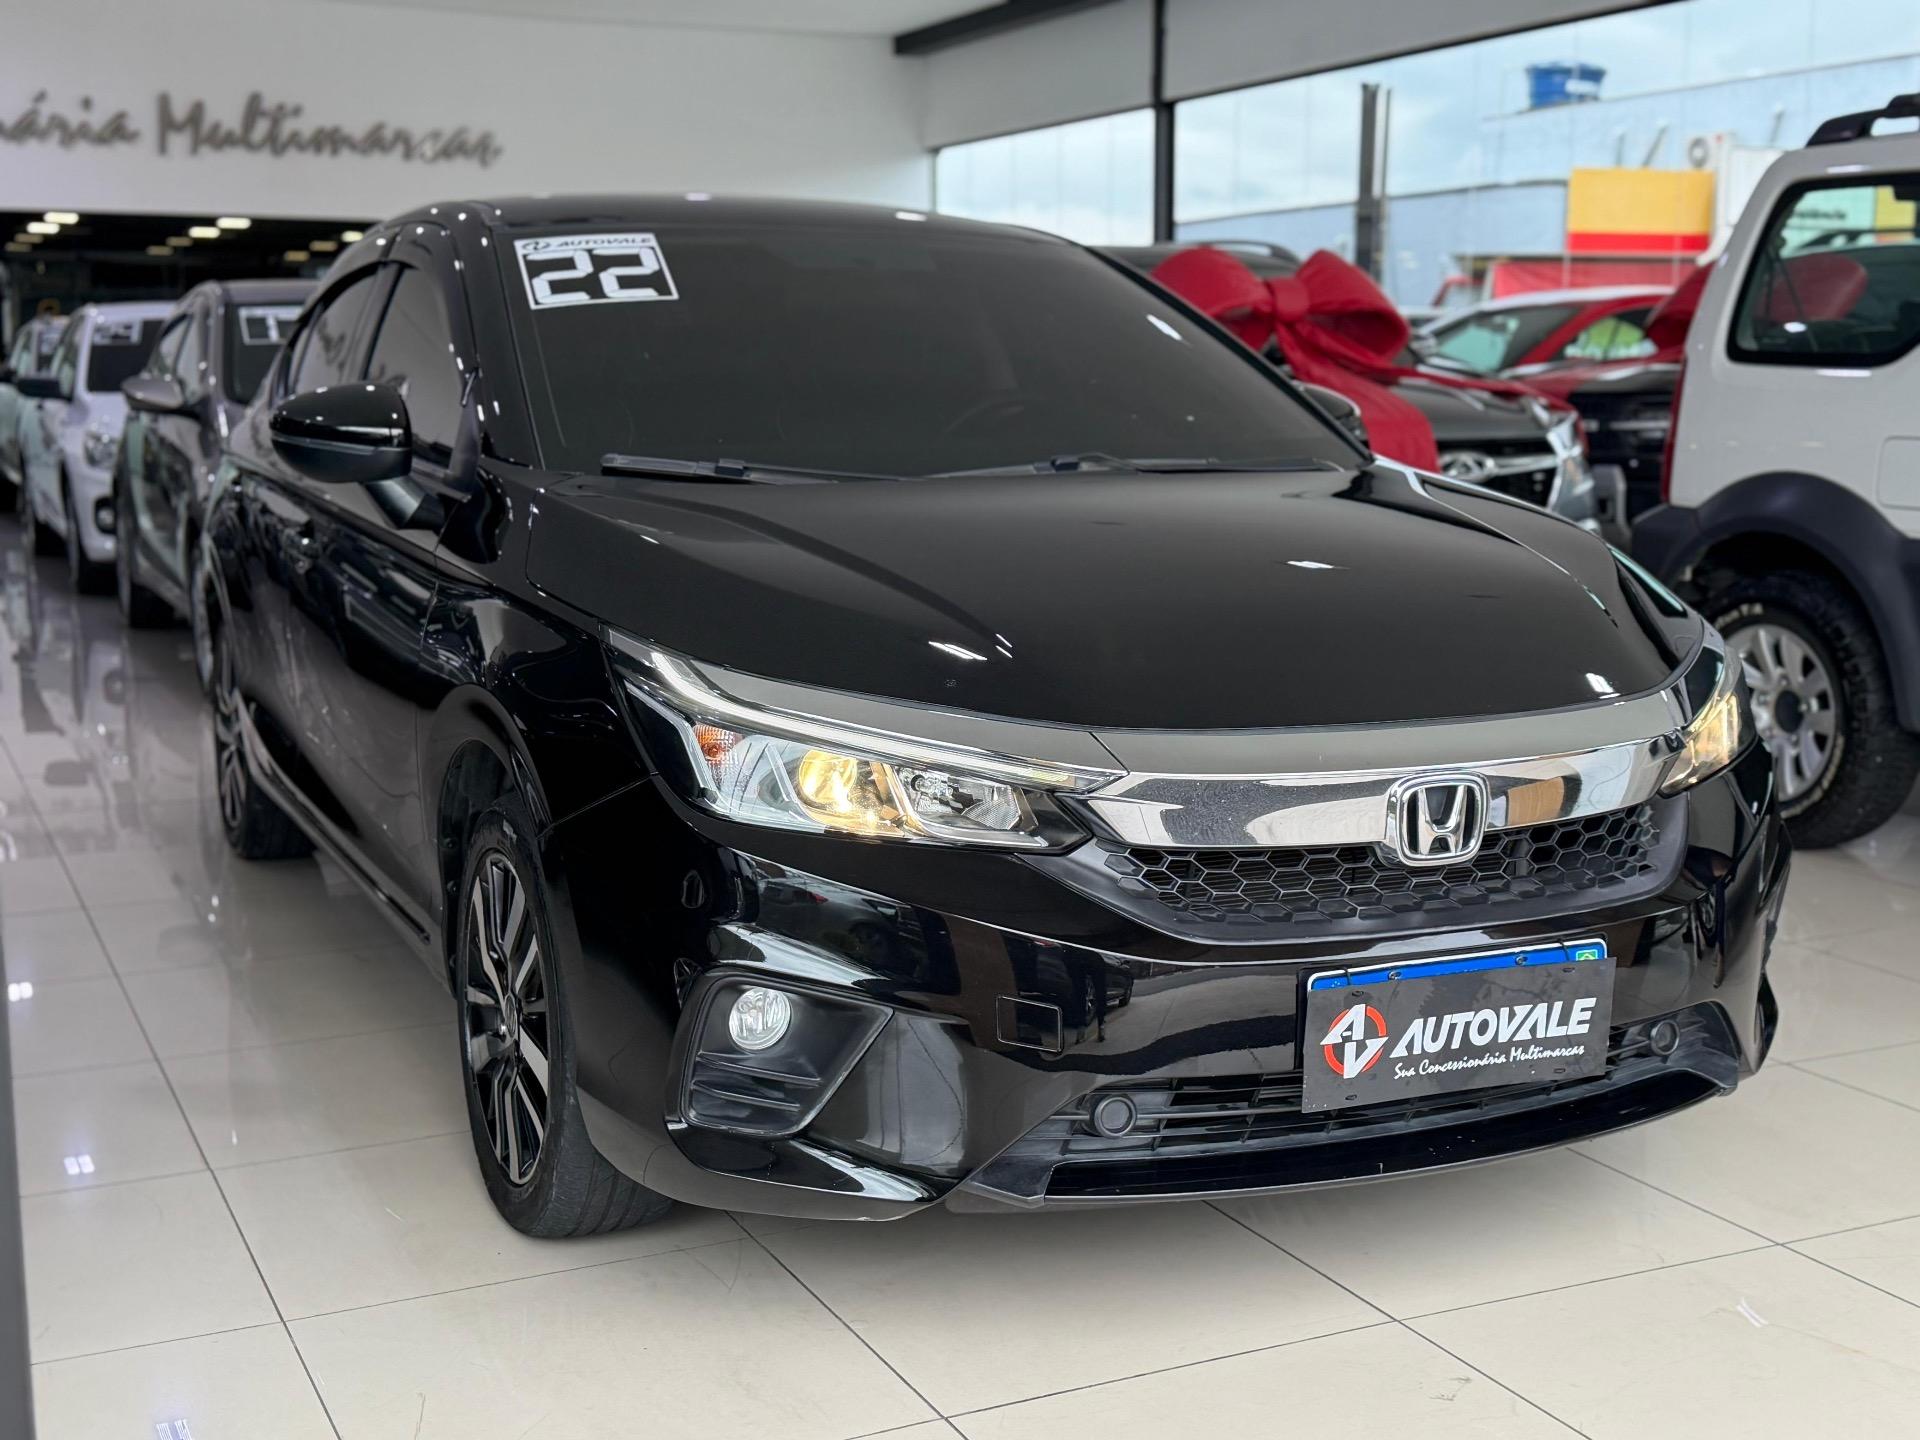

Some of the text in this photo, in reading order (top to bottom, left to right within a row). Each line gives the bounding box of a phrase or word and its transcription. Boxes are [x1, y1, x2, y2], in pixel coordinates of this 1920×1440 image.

[157, 91, 503, 168] Multimarcas
[557, 236, 652, 248] AUTOVALE
[526, 248, 660, 304] 22
[1389, 997, 1597, 1058] AUTOVALE
[1393, 1044, 1586, 1080] Sua Concessionária Multimarcas
